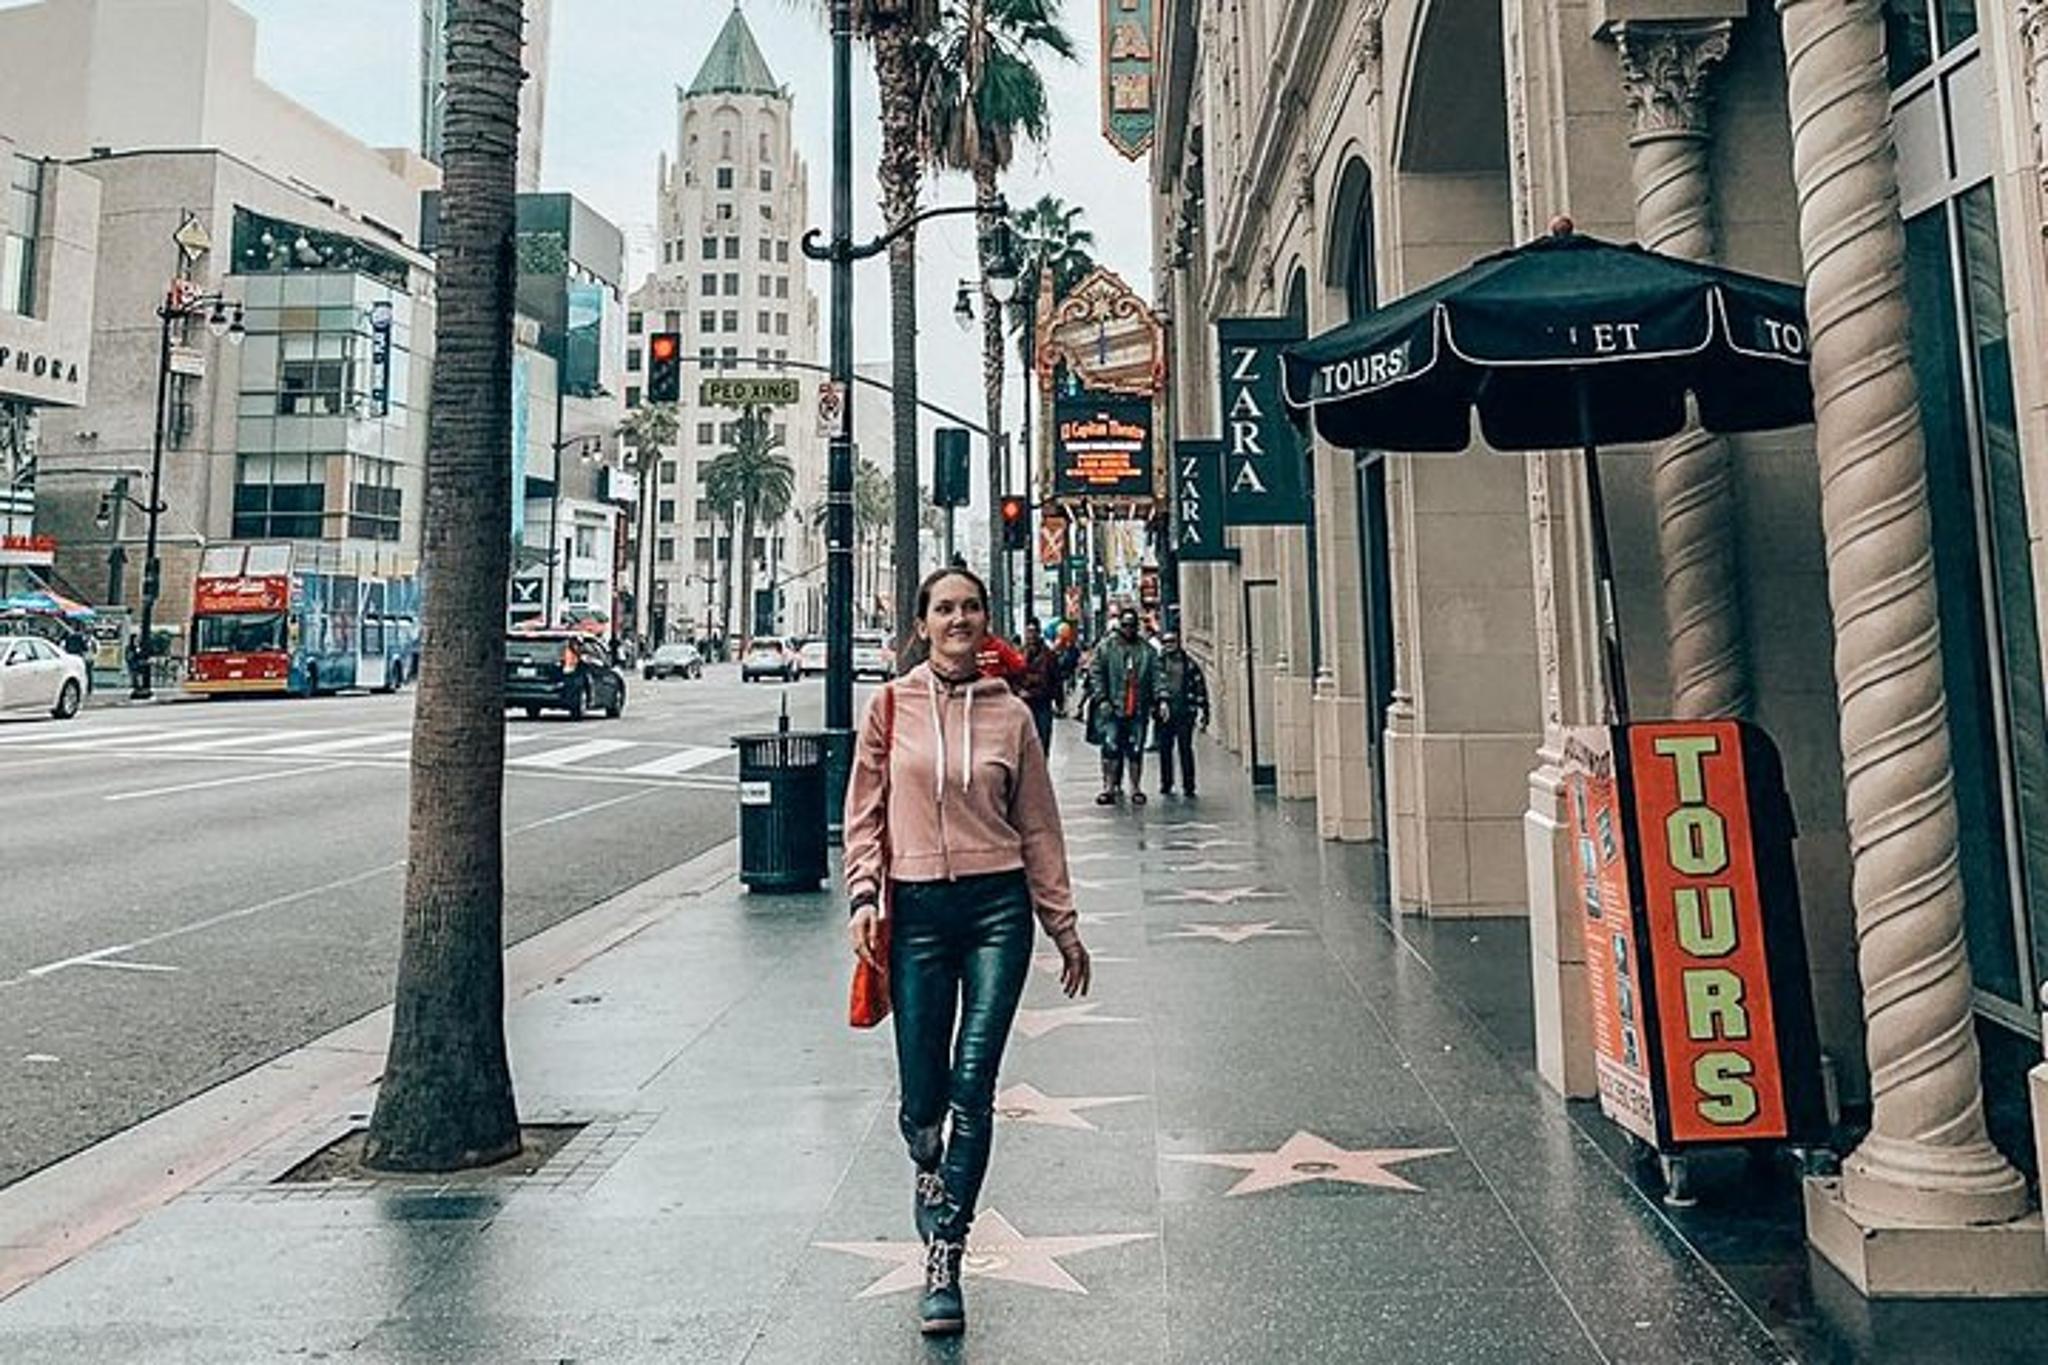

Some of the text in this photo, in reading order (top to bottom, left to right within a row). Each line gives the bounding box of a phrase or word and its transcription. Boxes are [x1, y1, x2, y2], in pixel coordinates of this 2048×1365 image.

[710, 383, 792, 399] PED XING
[1320, 347, 1404, 393] TOURS
[1229, 347, 1266, 493] ZARA
[1180, 457, 1201, 544] ZARA
[1655, 735, 1756, 1126] TOURS
